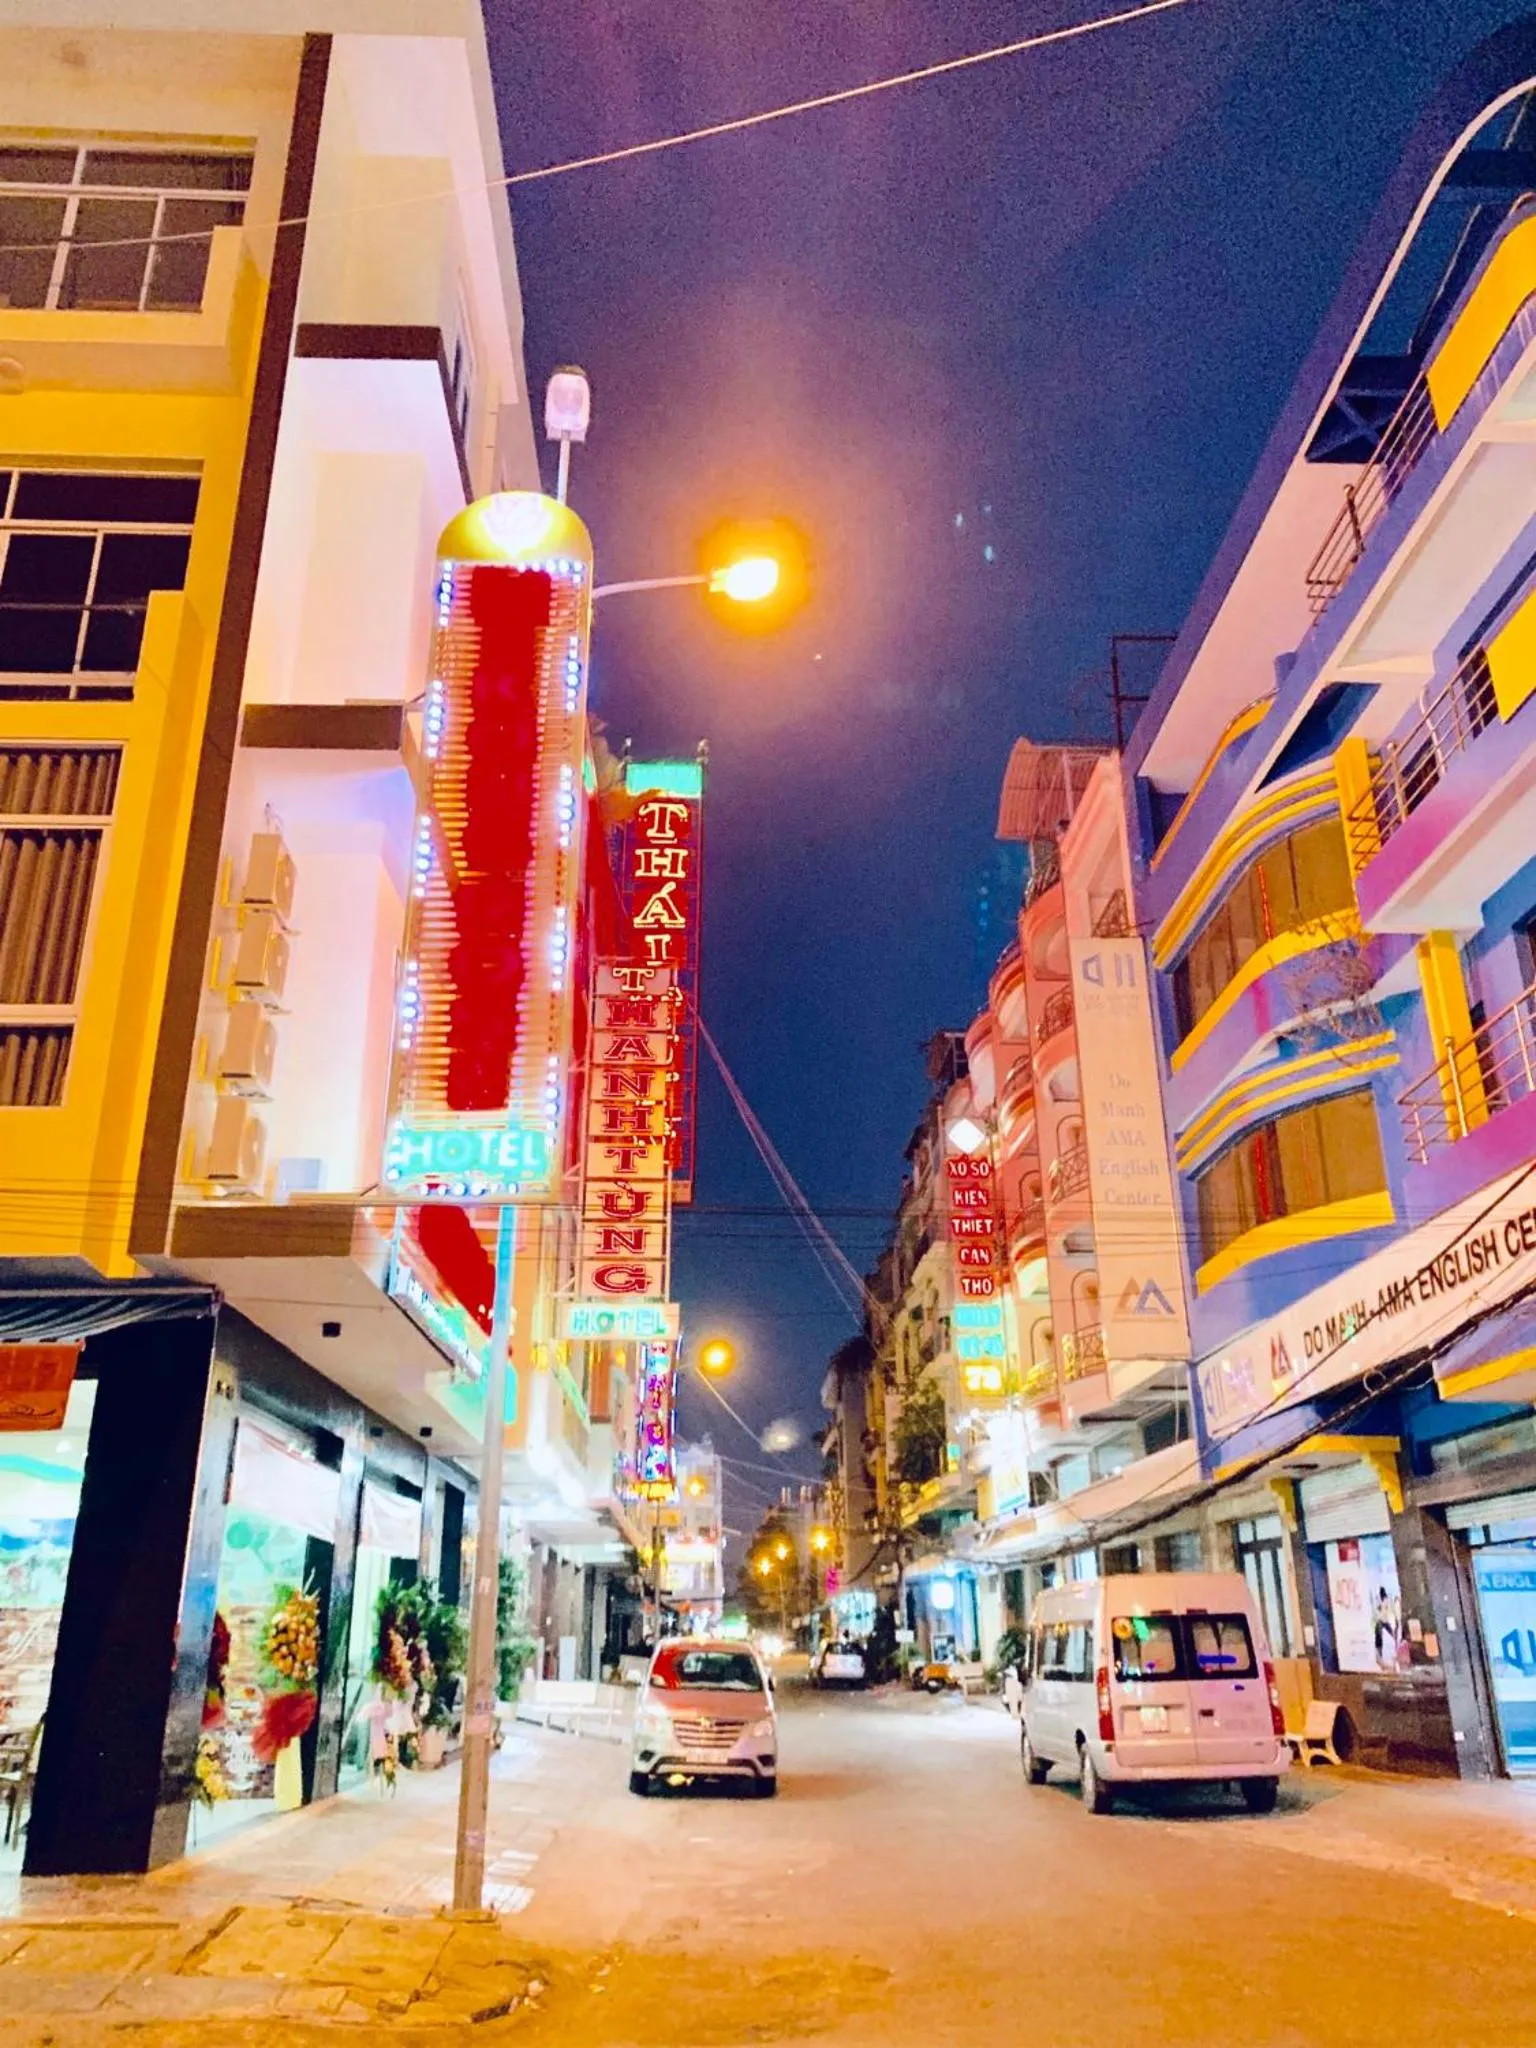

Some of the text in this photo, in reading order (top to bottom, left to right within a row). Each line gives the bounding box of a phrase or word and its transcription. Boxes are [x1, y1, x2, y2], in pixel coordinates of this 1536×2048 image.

[401, 1131, 541, 1170] HOTEL
[1099, 1159, 1159, 1180] English
[1104, 1187, 1161, 1206] Center
[1417, 1228, 1501, 1300] ENGLISH
[1503, 1206, 1536, 1258] CE
[571, 1306, 668, 1335] HOTEL
